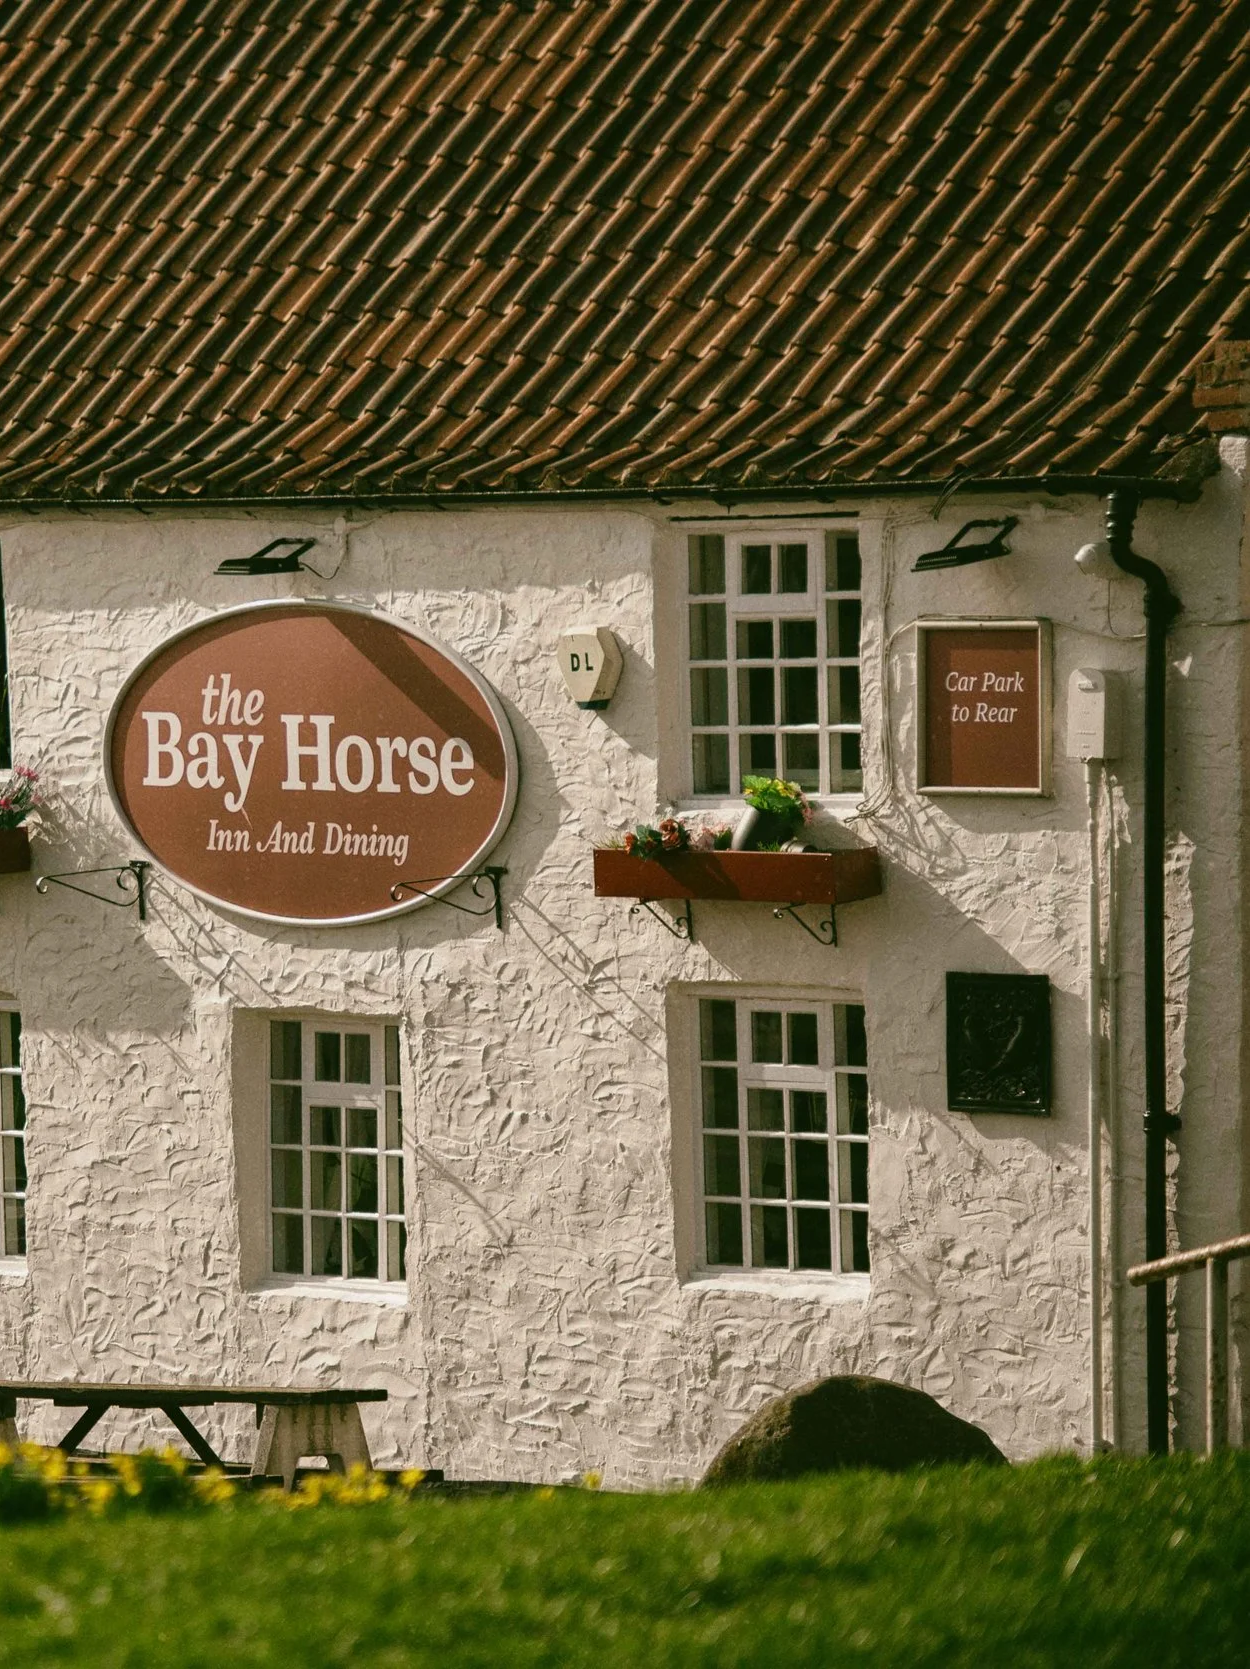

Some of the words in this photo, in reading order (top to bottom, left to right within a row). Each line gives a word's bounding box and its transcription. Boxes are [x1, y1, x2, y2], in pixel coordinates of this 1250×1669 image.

[570, 652, 594, 672] DL
[945, 671, 978, 692] Car
[981, 671, 1025, 692] Park
[201, 673, 264, 726] the
[952, 703, 970, 722] to
[973, 702, 1018, 723] Rear
[141, 711, 264, 813] Bay
[280, 714, 475, 797] Horse
[206, 819, 251, 852] Inn
[256, 821, 316, 855] And
[322, 822, 410, 867] Dining
